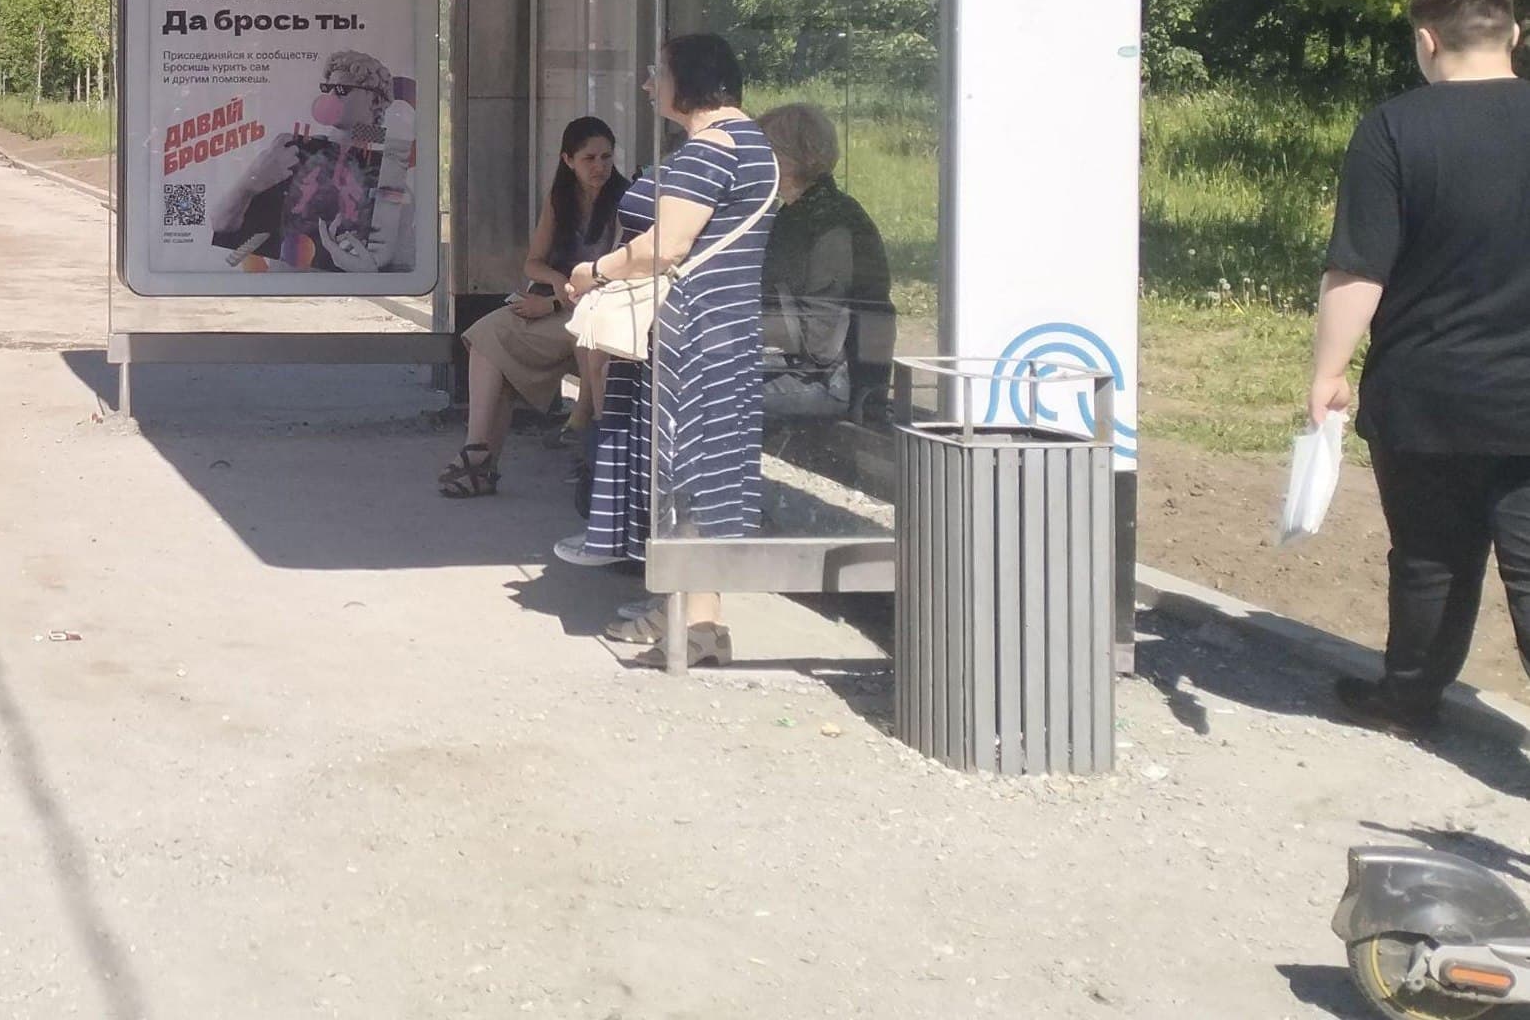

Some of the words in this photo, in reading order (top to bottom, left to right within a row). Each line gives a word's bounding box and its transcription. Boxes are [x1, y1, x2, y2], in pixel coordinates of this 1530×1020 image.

[162, 10, 208, 35] Да
[214, 9, 310, 36] брось
[315, 14, 366, 31] ты.
[162, 50, 245, 61] Присоединяйся
[247, 52, 254, 60] к
[162, 62, 210, 73] Бросишь
[212, 63, 248, 73] курить
[249, 64, 270, 72] сам
[163, 76, 170, 84] и
[172, 76, 210, 85] другим
[212, 76, 271, 84] поможешь.
[164, 96, 244, 153] ДАВАЙ
[164, 120, 265, 176] БРОСАТЬ
